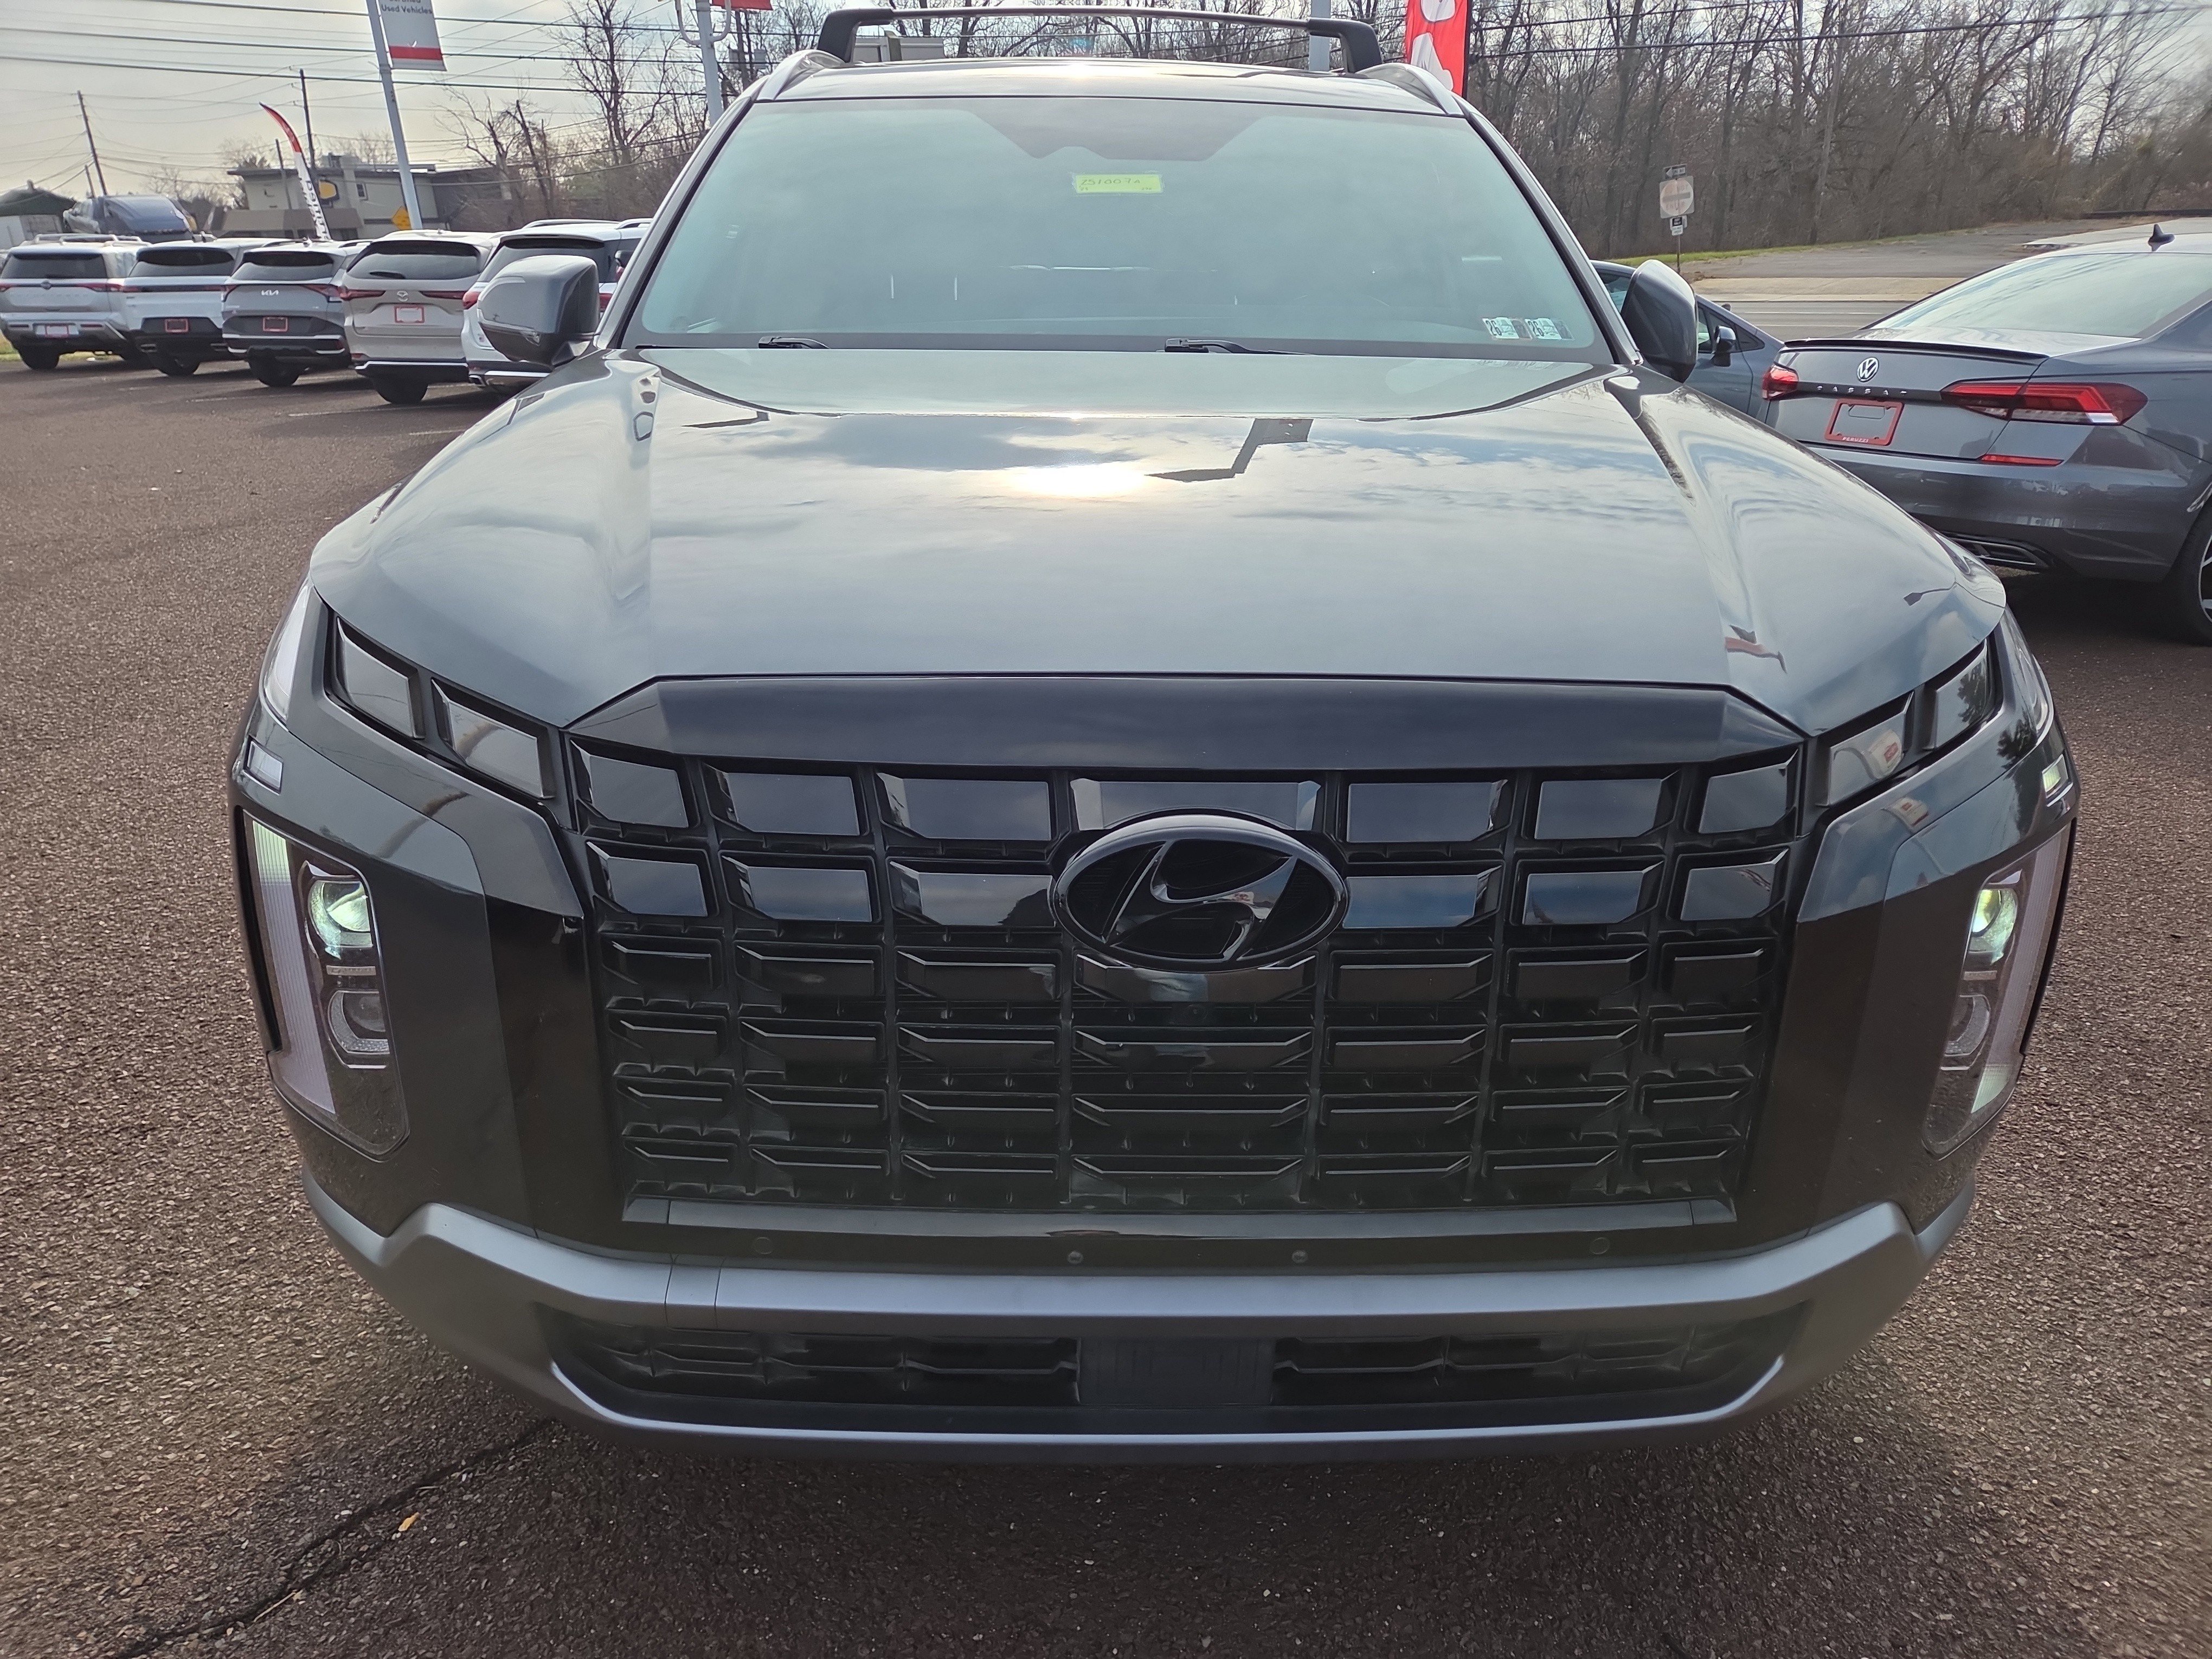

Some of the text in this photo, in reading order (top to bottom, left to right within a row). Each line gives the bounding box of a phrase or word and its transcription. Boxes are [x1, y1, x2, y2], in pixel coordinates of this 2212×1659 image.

[381, 4, 433, 14] Used Vehicles
[1485, 320, 1502, 336] 26
[1527, 320, 1545, 337] 26
